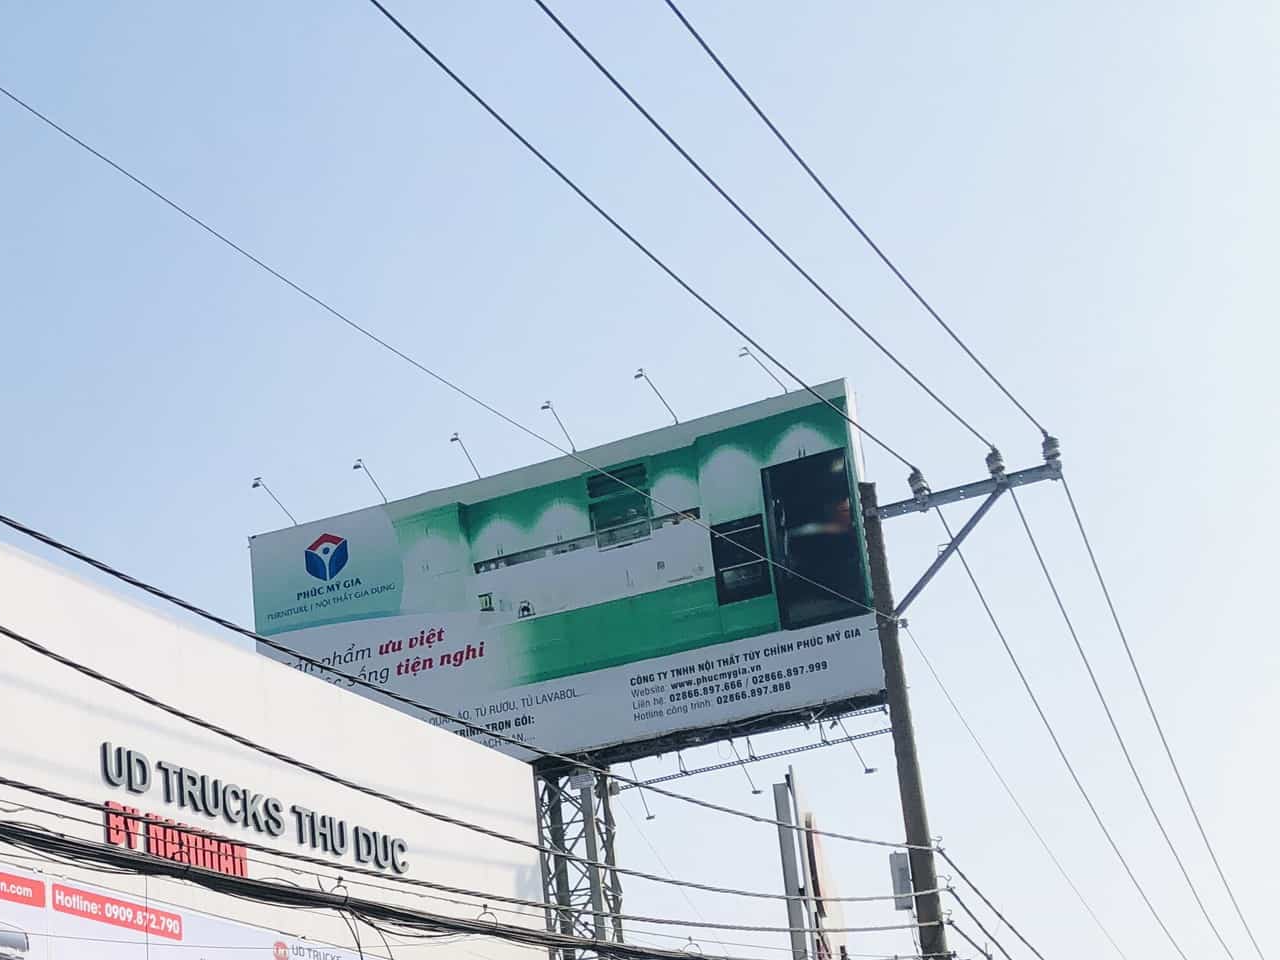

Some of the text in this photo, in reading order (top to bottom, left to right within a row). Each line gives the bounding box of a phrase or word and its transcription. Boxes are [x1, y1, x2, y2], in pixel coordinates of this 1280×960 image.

[296, 586, 325, 601] PHÚC
[343, 577, 362, 589] GIA
[354, 589, 370, 600] GIA
[378, 639, 402, 656] ưu
[409, 626, 447, 650] việt
[395, 656, 433, 678] tiện
[439, 641, 485, 668] nghi
[629, 671, 656, 687] CÔNG
[657, 669, 668, 682] TY
[670, 664, 696, 680] TNHH
[698, 659, 715, 675] NỘI
[796, 633, 825, 651] PHÚC
[844, 627, 862, 642] GIA
[670, 663, 762, 692] www.phucmygia.vn
[633, 706, 665, 722] Hotline
[100, 742, 410, 874] UD TRUCKS THU DUC
[104, 800, 141, 850] BY
[55, 889, 180, 934] Hotline: 0909.872.790
[291, 943, 305, 957] UD
